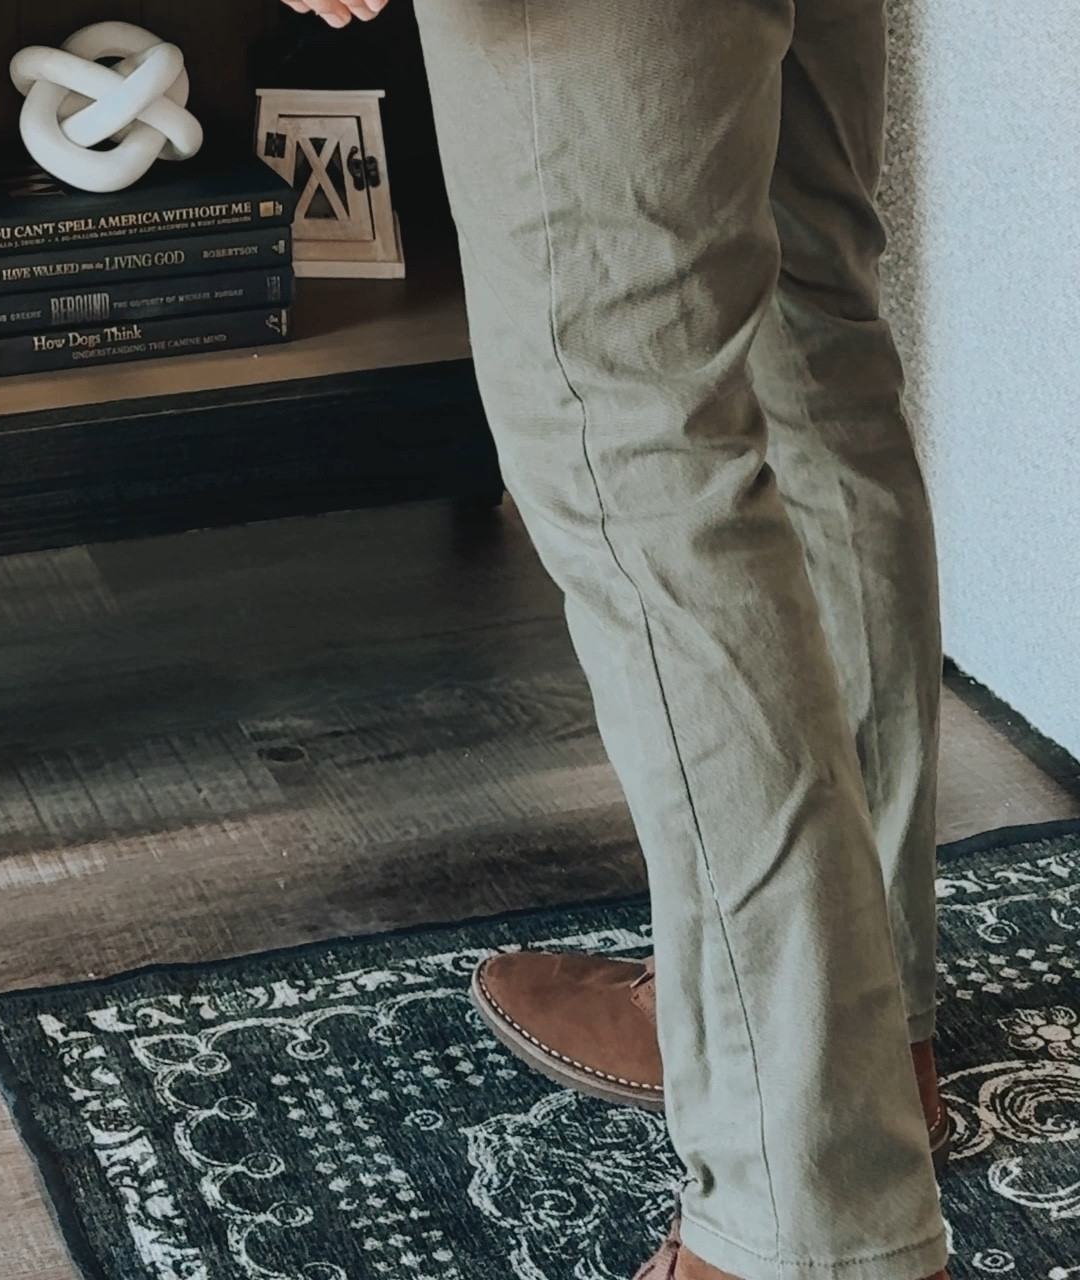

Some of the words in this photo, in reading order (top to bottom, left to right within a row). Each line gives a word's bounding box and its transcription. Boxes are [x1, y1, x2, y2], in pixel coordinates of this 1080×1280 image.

[14, 222, 56, 238] CAN'T
[58, 218, 96, 233] SPELL
[98, 212, 160, 229] AMERICA
[162, 203, 229, 221] WITHOUT
[231, 202, 252, 214] ME
[2, 267, 31, 280] HAVE
[32, 263, 79, 277] WALKED
[104, 252, 152, 271] LIVING
[154, 250, 185, 266] GOD
[203, 246, 258, 259] ROBERTSON
[51, 293, 110, 326] REBOUND
[33, 336, 65, 351] How
[67, 332, 101, 348] Dogs
[103, 324, 142, 343] Think
[72, 343, 146, 360] UNDERSTANDING
[148, 340, 166, 351] THE
[168, 336, 201, 348] CANINE
[203, 333, 227, 344] MIND
